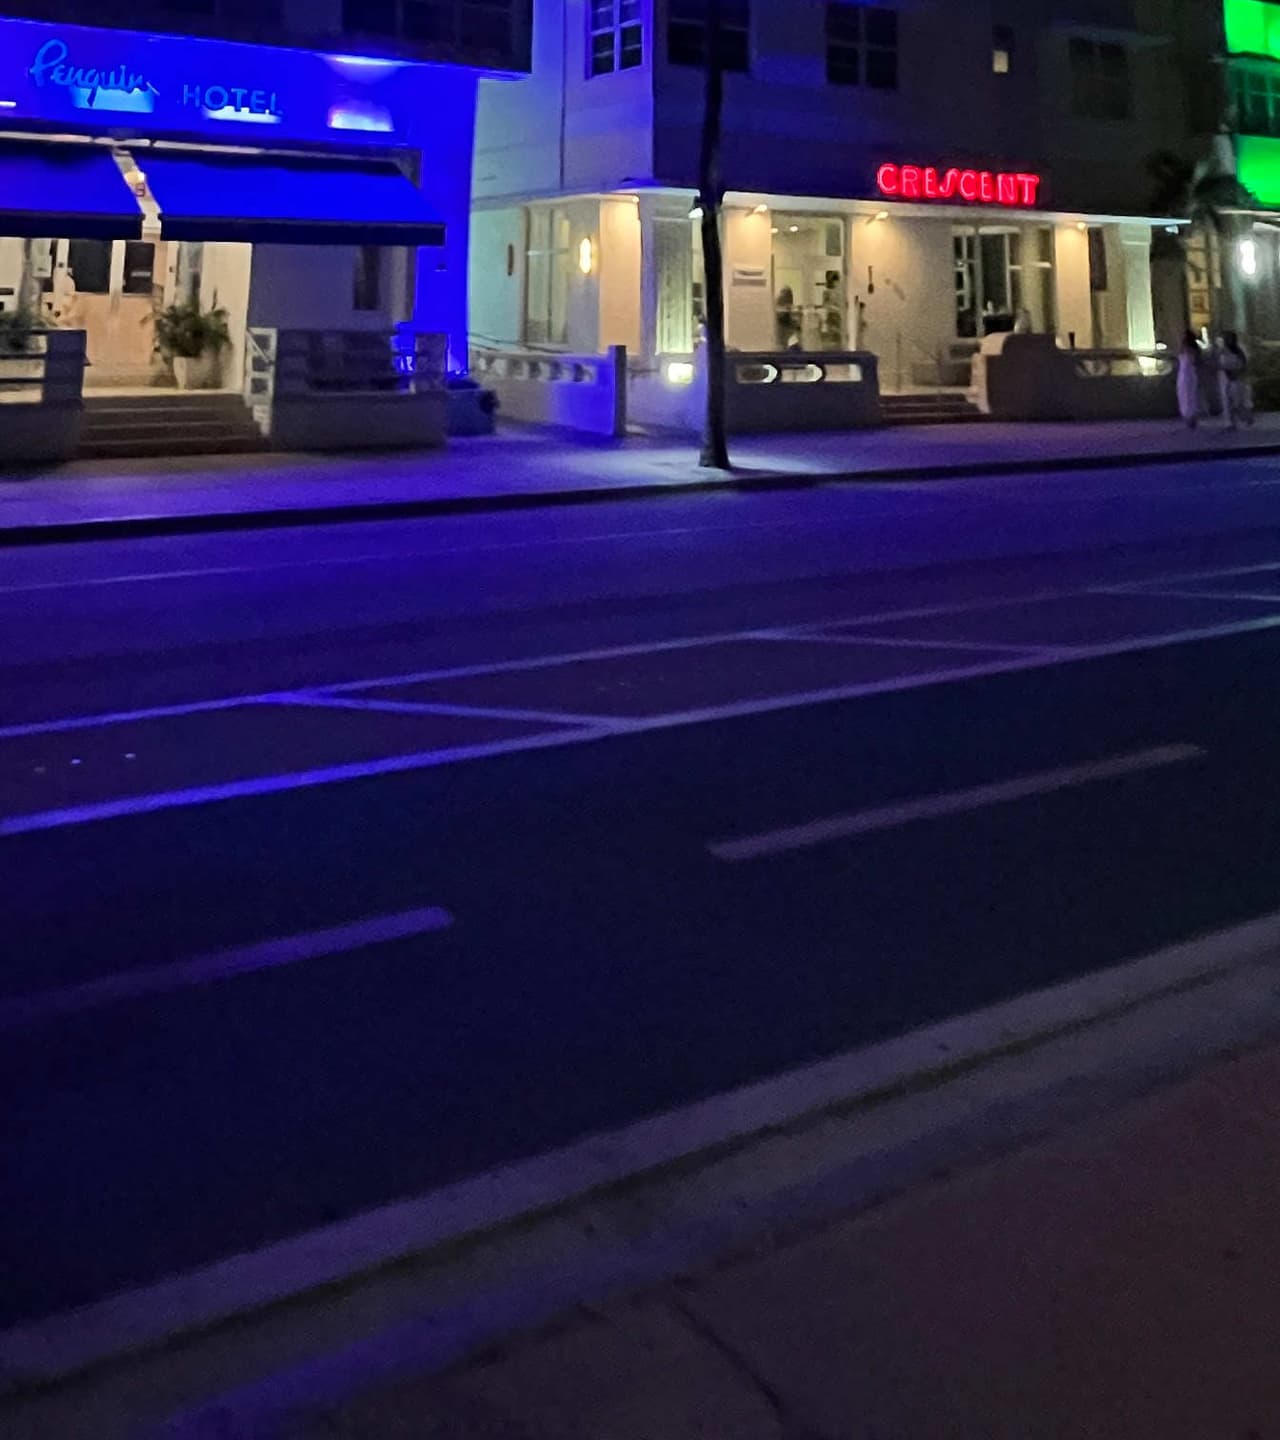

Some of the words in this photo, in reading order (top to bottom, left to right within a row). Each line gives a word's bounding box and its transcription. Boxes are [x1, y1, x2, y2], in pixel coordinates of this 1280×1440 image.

[26, 39, 160, 107] Penguin
[183, 84, 282, 116] HOTEL
[876, 162, 1040, 205] CRESCENT
